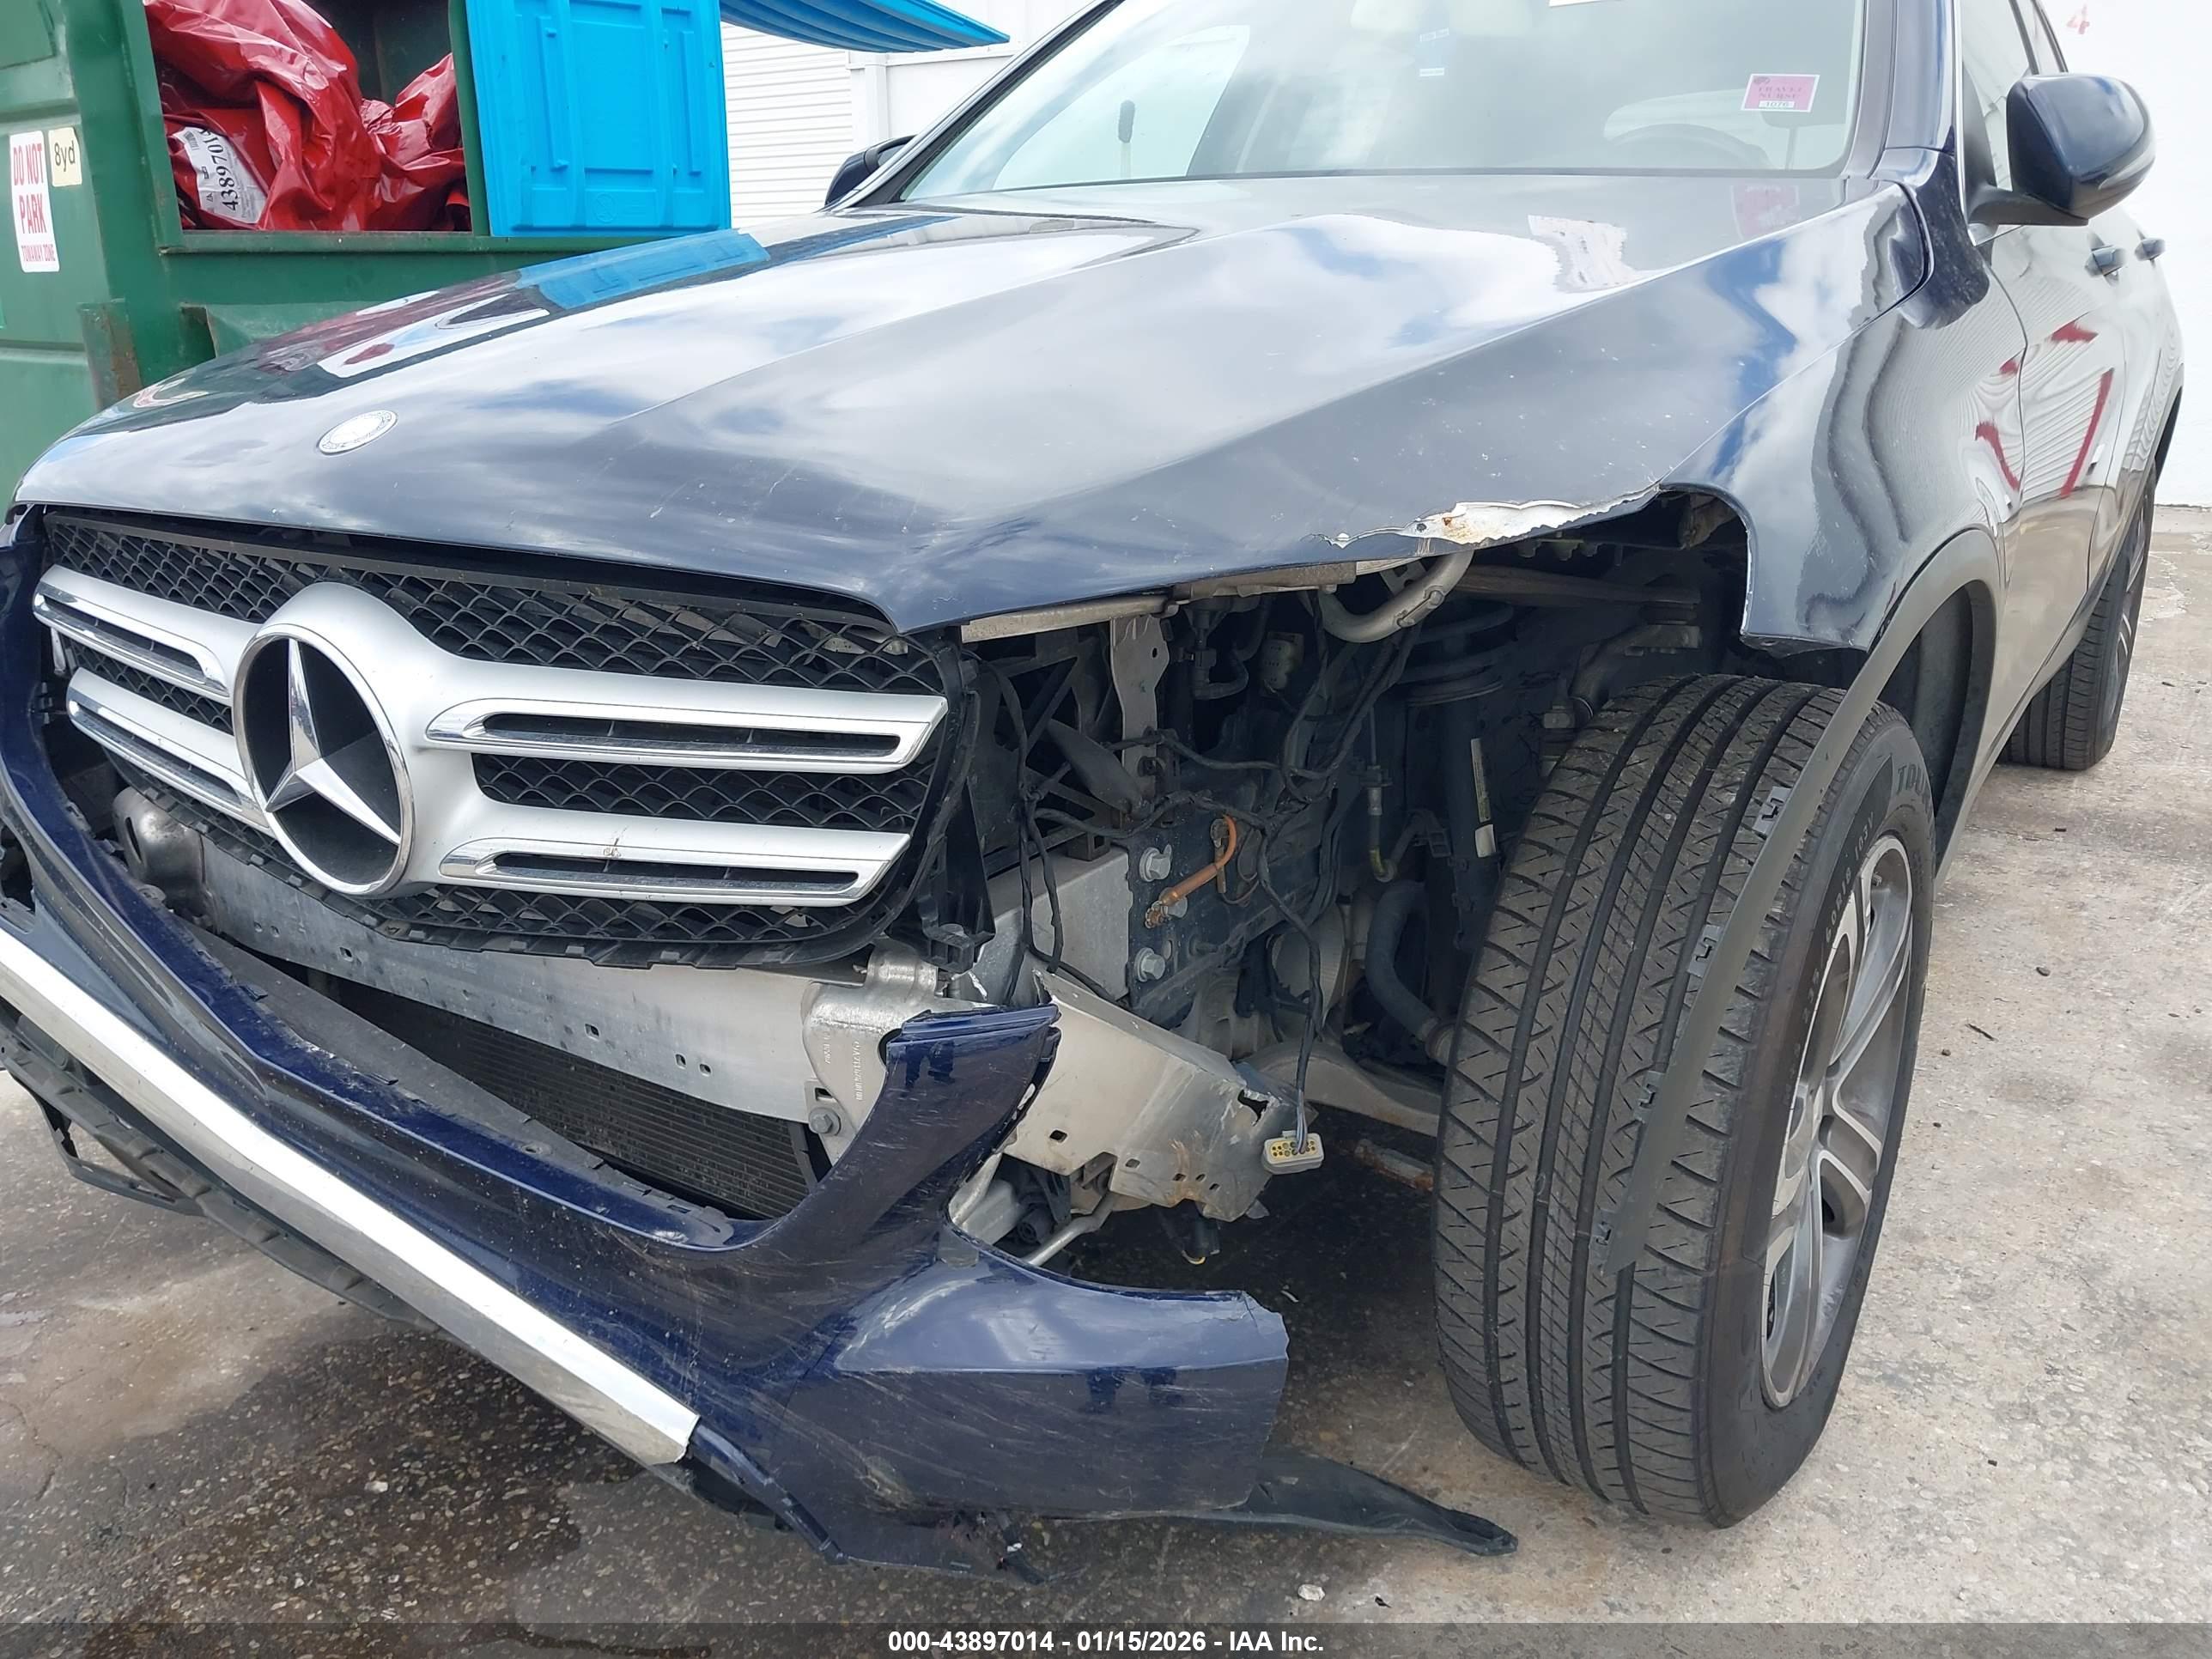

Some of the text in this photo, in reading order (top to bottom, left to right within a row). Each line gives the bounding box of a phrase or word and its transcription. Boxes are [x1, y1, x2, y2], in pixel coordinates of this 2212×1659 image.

[13, 143, 44, 186] DO NOT
[54, 140, 76, 172] 8yd
[19, 193, 47, 234] PARK
[43, 243, 56, 262] ZONE
